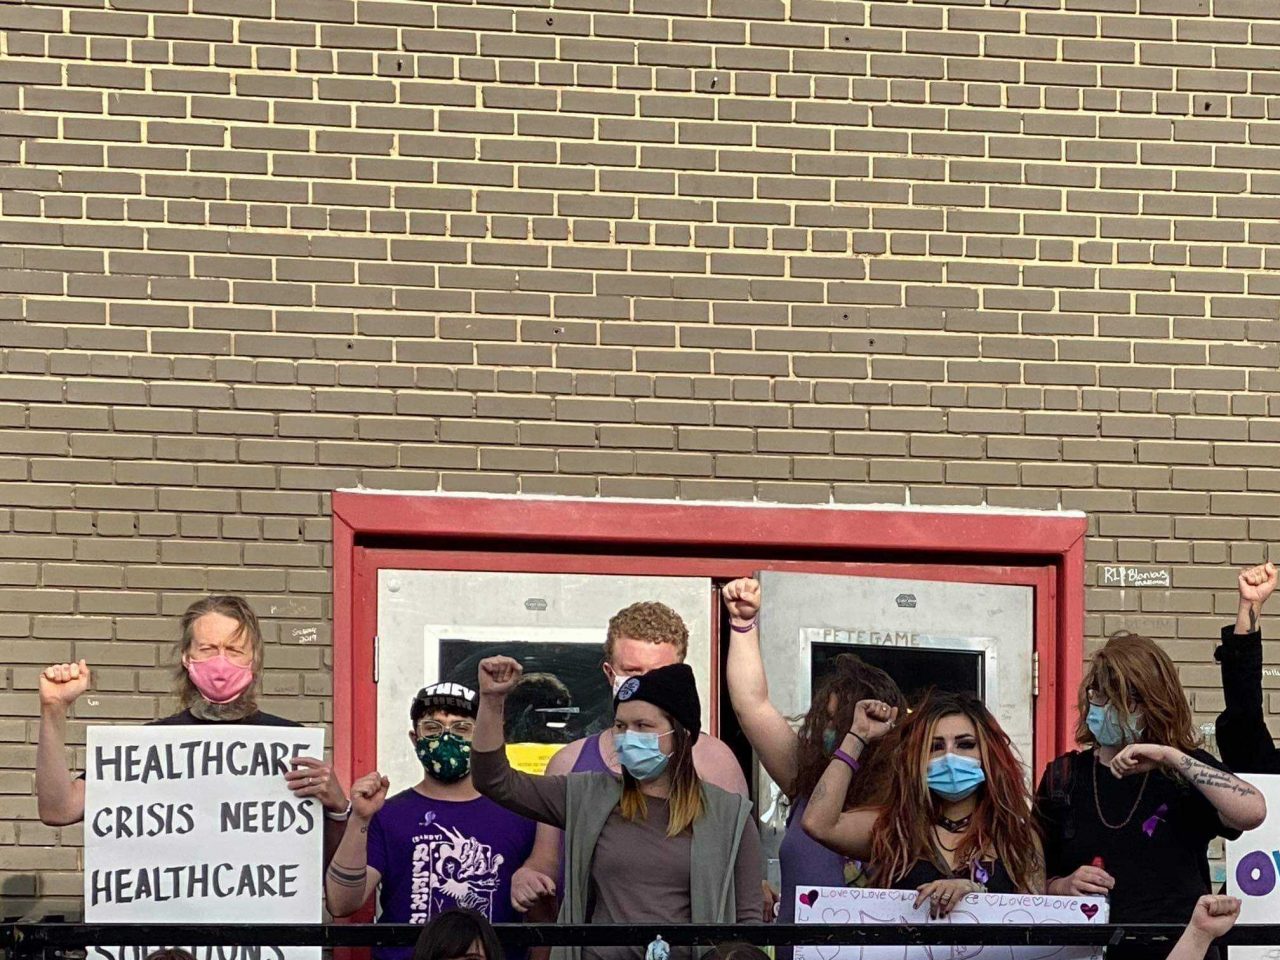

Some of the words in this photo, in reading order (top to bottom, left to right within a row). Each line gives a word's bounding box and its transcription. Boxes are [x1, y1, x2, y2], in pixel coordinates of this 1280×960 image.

[425, 682, 476, 701] THEY
[95, 740, 311, 784] HEALTHCARE
[92, 802, 195, 839] CRISIS
[220, 800, 314, 835] NEEDS
[92, 862, 300, 906] HEALTHCARE
